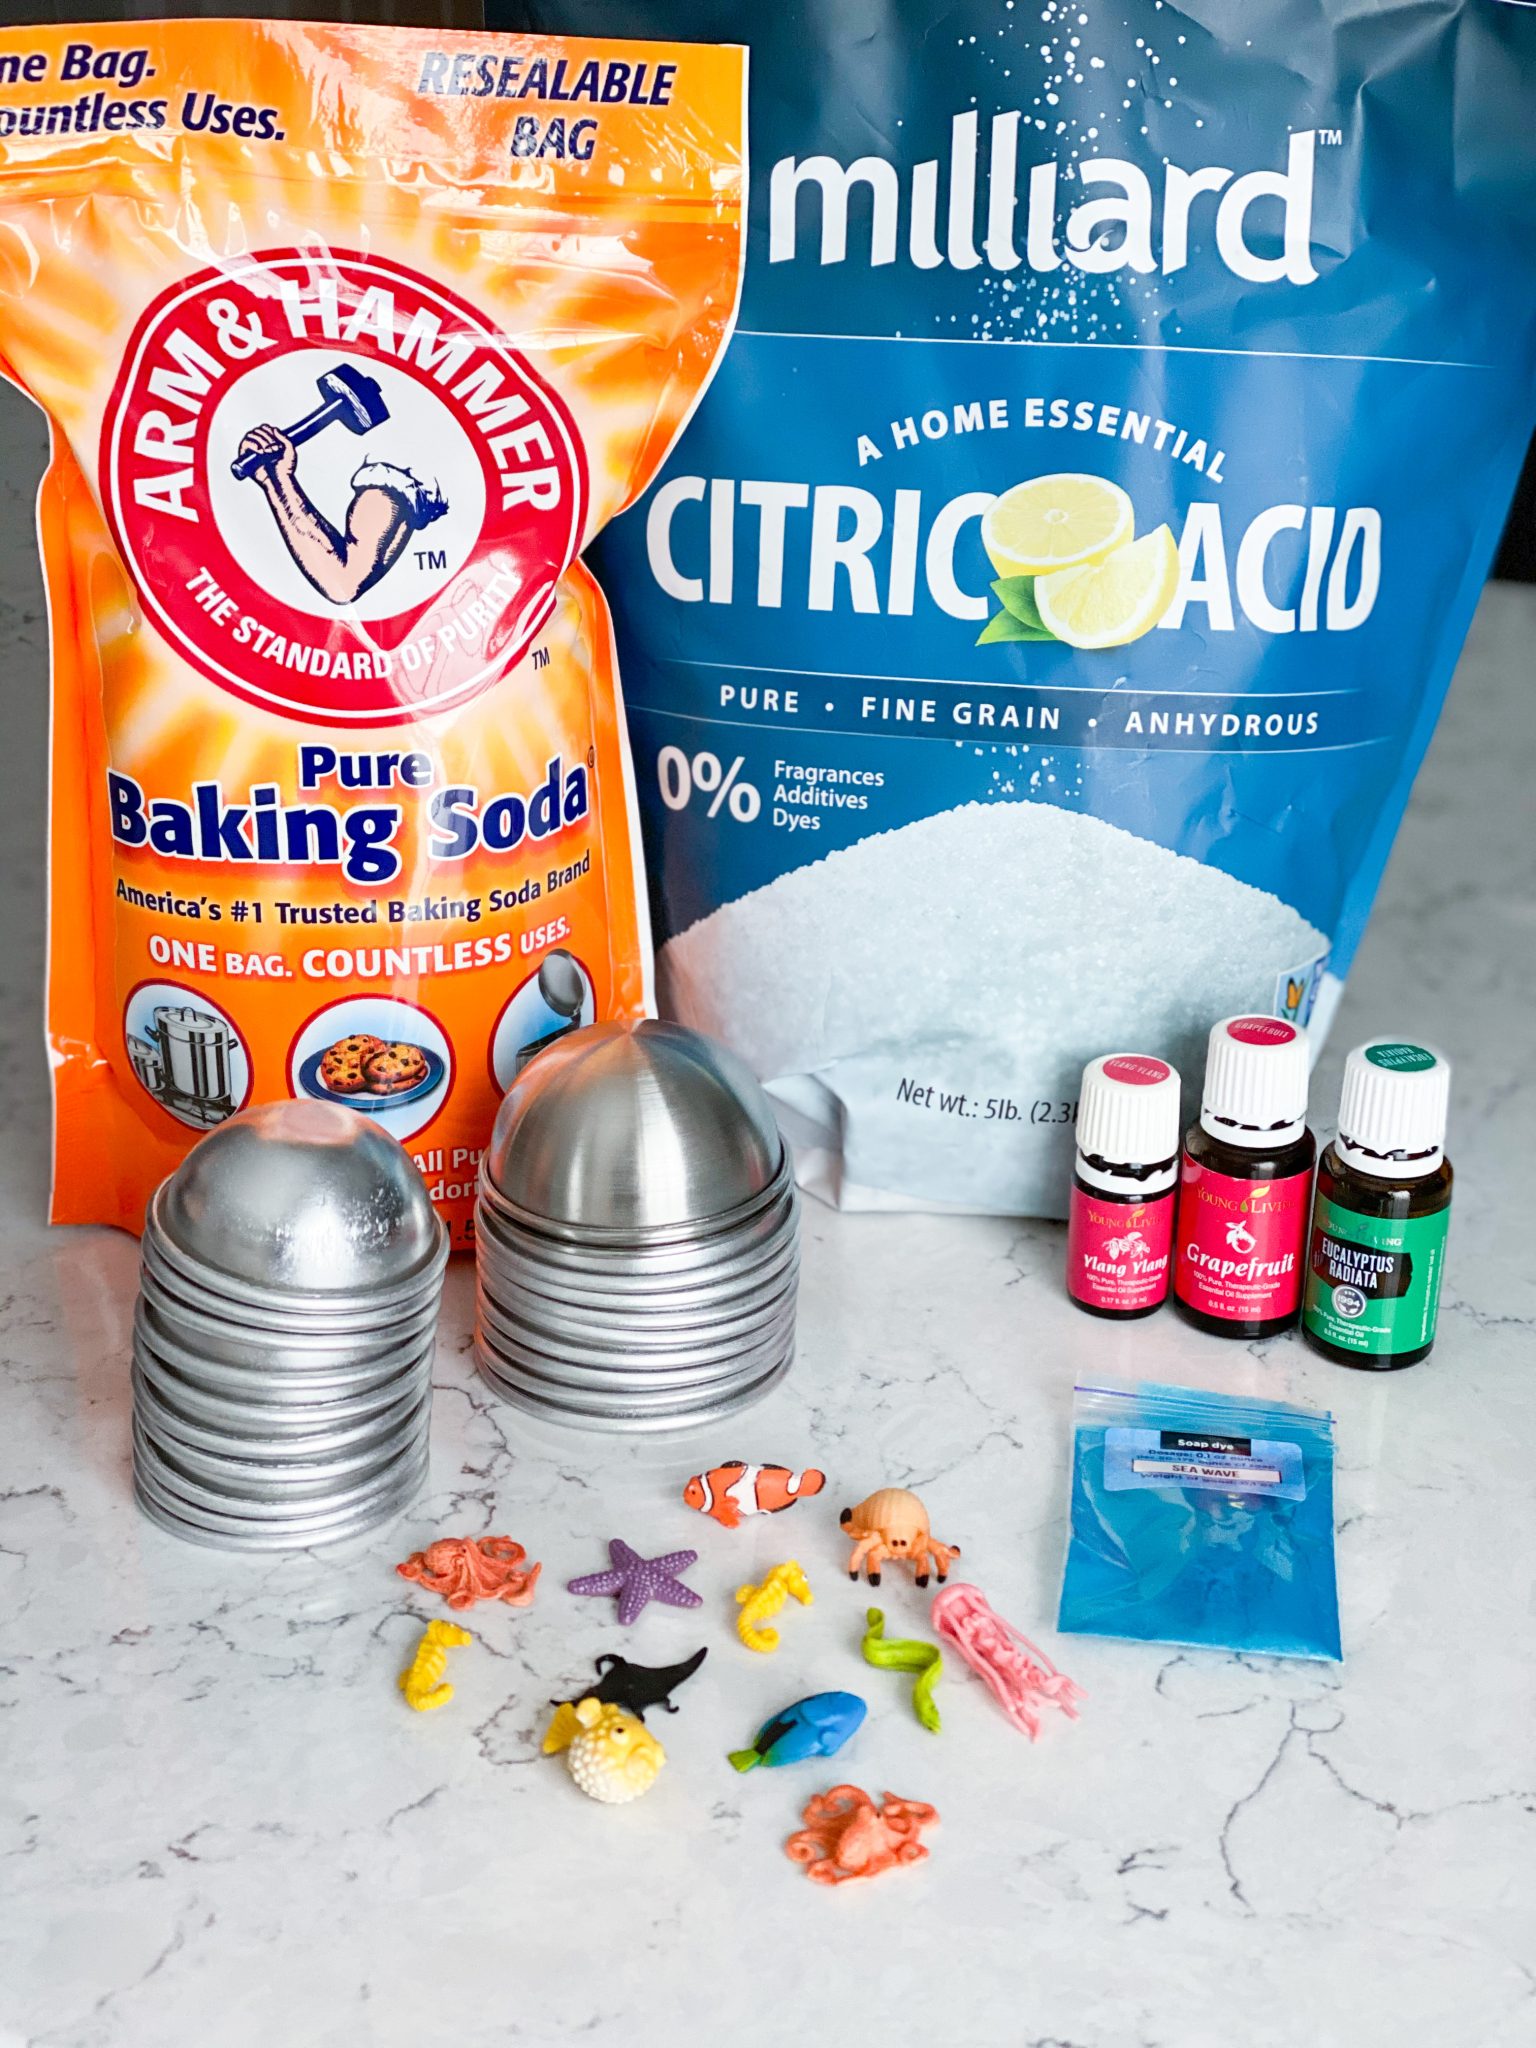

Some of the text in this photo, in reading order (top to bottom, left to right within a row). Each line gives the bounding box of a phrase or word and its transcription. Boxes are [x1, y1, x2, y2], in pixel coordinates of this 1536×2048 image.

[0, 44, 156, 88] ne Bag.
[418, 51, 677, 106] RESEALABLE
[0, 92, 285, 140] ountless Uses.
[510, 116, 598, 160] BAG
[770, 109, 1319, 285] milliard
[134, 278, 561, 523] ARM & HAMMER
[856, 397, 1226, 484] A HOME ESSENTIAL
[645, 475, 1382, 634] CITRIC ACID
[186, 562, 523, 680] THE STANDARD OF PURITY
[720, 685, 1319, 736] PURE FINE GRAIN ANHYDROUS
[299, 745, 433, 788] Pure
[657, 745, 762, 823] 0%
[774, 759, 885, 787] Fragrances
[107, 755, 588, 882] Baking Soda
[773, 784, 868, 810] Additives
[772, 808, 821, 832] Dyes
[116, 848, 591, 924] America's #1 Trusted Baking Soda Brand
[150, 915, 571, 977] ONE BAG. COUNTLESS USES.
[896, 1077, 935, 1109] Net
[939, 1092, 977, 1118] wt.:
[984, 1098, 1022, 1121] 5lb.
[413, 1149, 443, 1173] All
[1084, 1254, 1168, 1278] Ylang Ylang
[1187, 1243, 1295, 1281] Grapefruit
[1322, 1237, 1394, 1273] EUCALYPTUS
[1329, 1260, 1377, 1289] RADIATA
[1178, 1439, 1234, 1451] Soap dye
[1172, 1464, 1240, 1478] SEA WAVE
